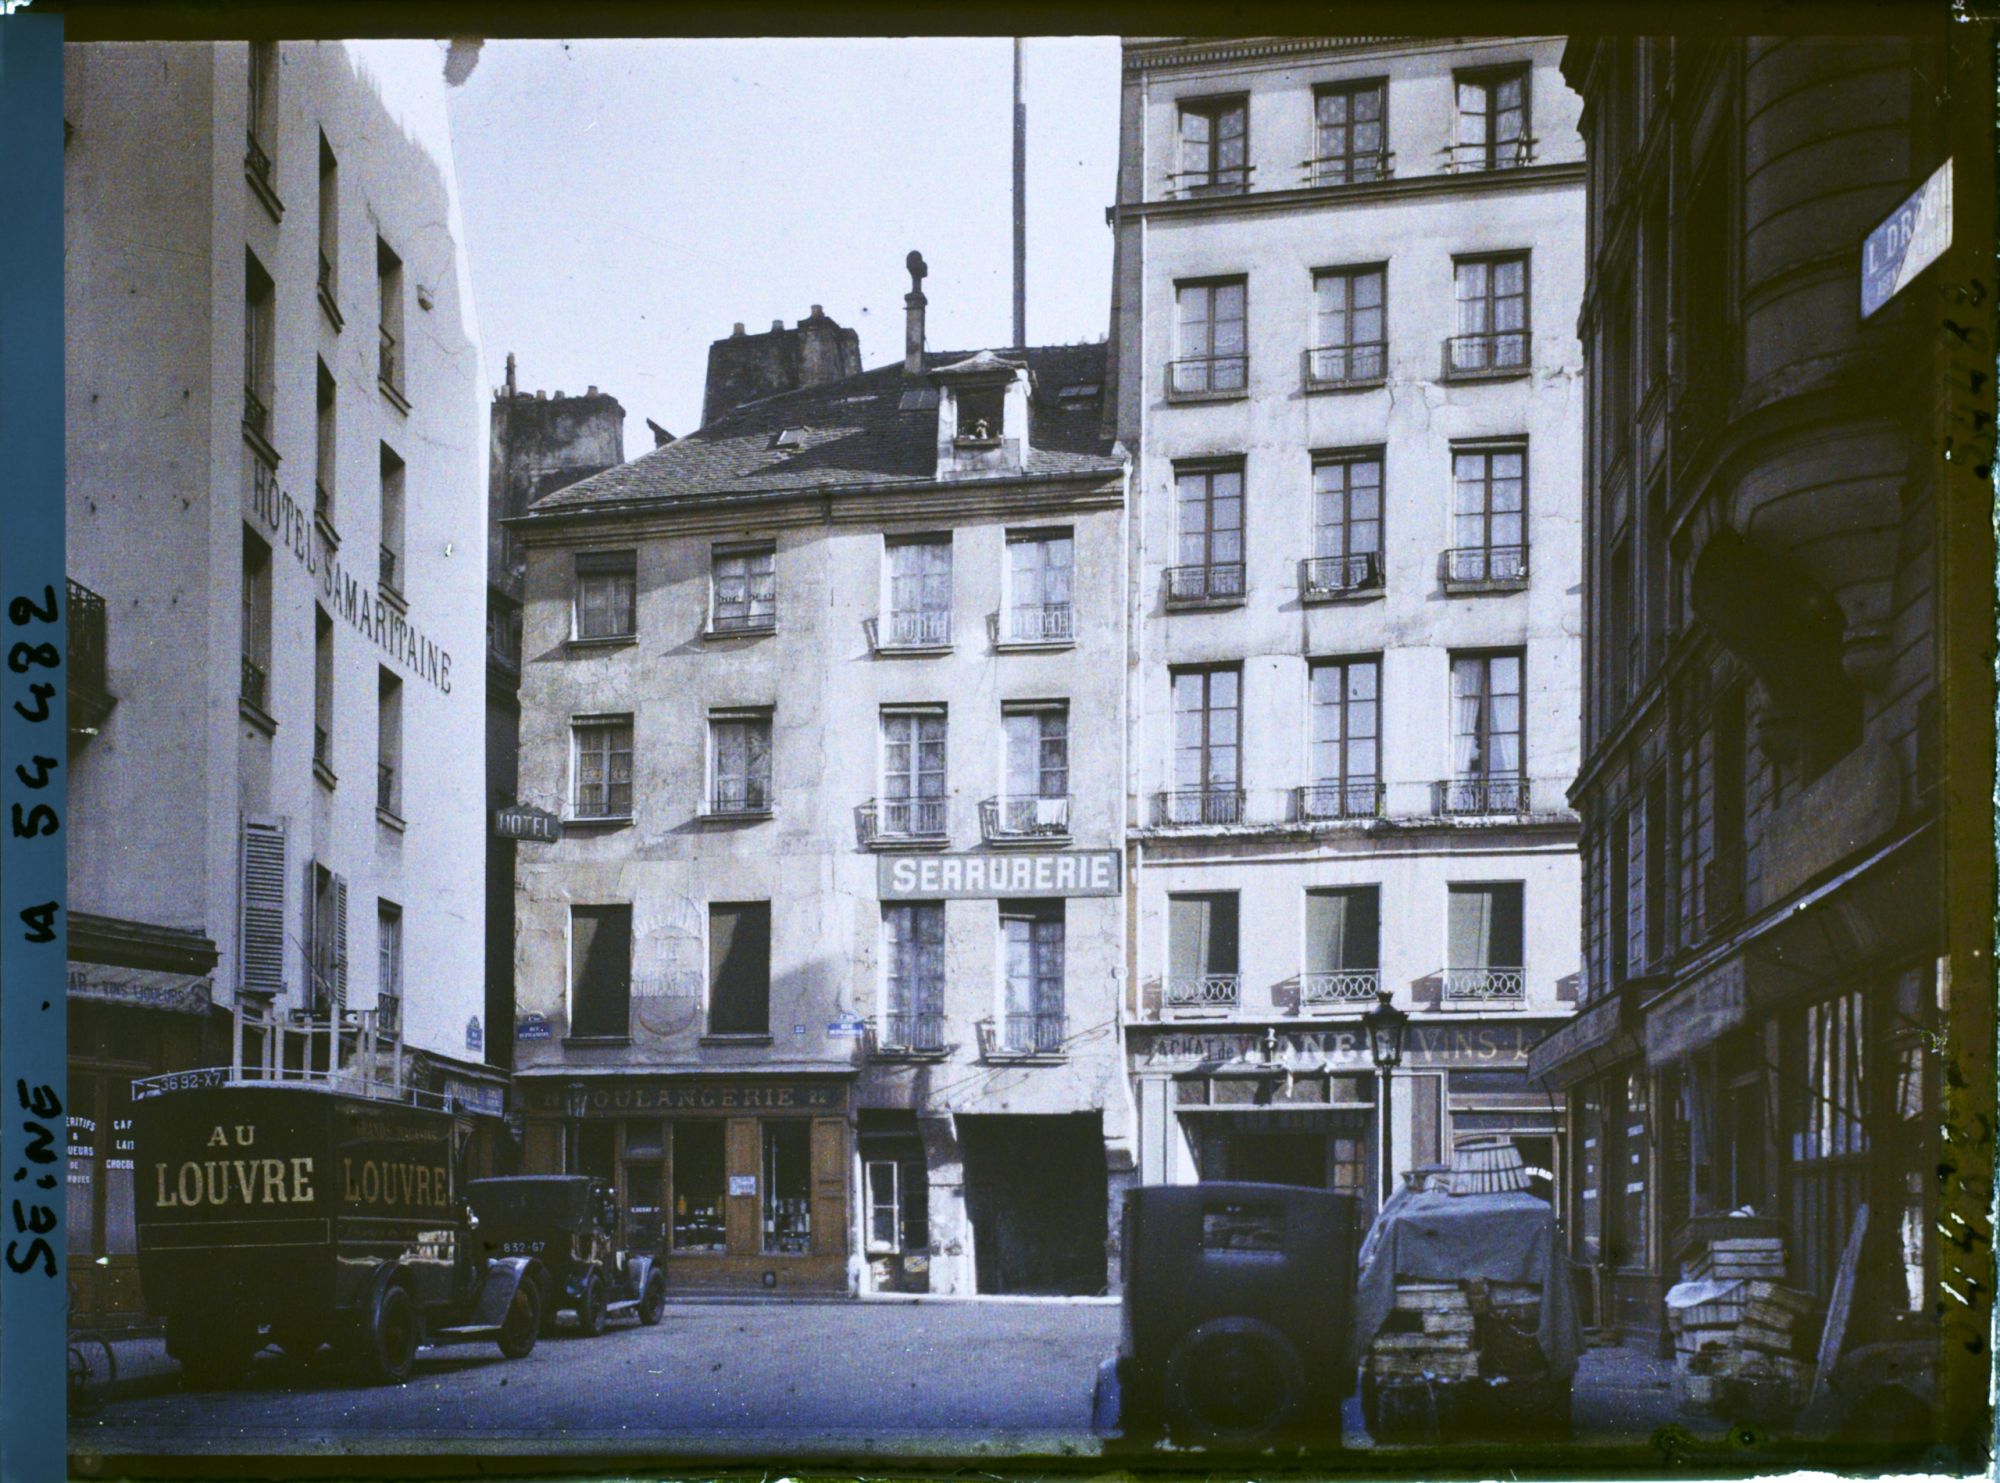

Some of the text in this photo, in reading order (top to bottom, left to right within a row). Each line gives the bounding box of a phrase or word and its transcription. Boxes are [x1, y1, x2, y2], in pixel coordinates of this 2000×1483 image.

[253, 459, 452, 694] HOTEL SAMARITAINE
[499, 813, 552, 838] HOTEL
[893, 857, 1110, 892] SERRURERIE
[572, 1088, 795, 1109] OULANGERIE
[207, 1125, 256, 1147] AU
[155, 1157, 315, 1207] LOUVRE
[344, 1157, 448, 1208] LOUVRE
